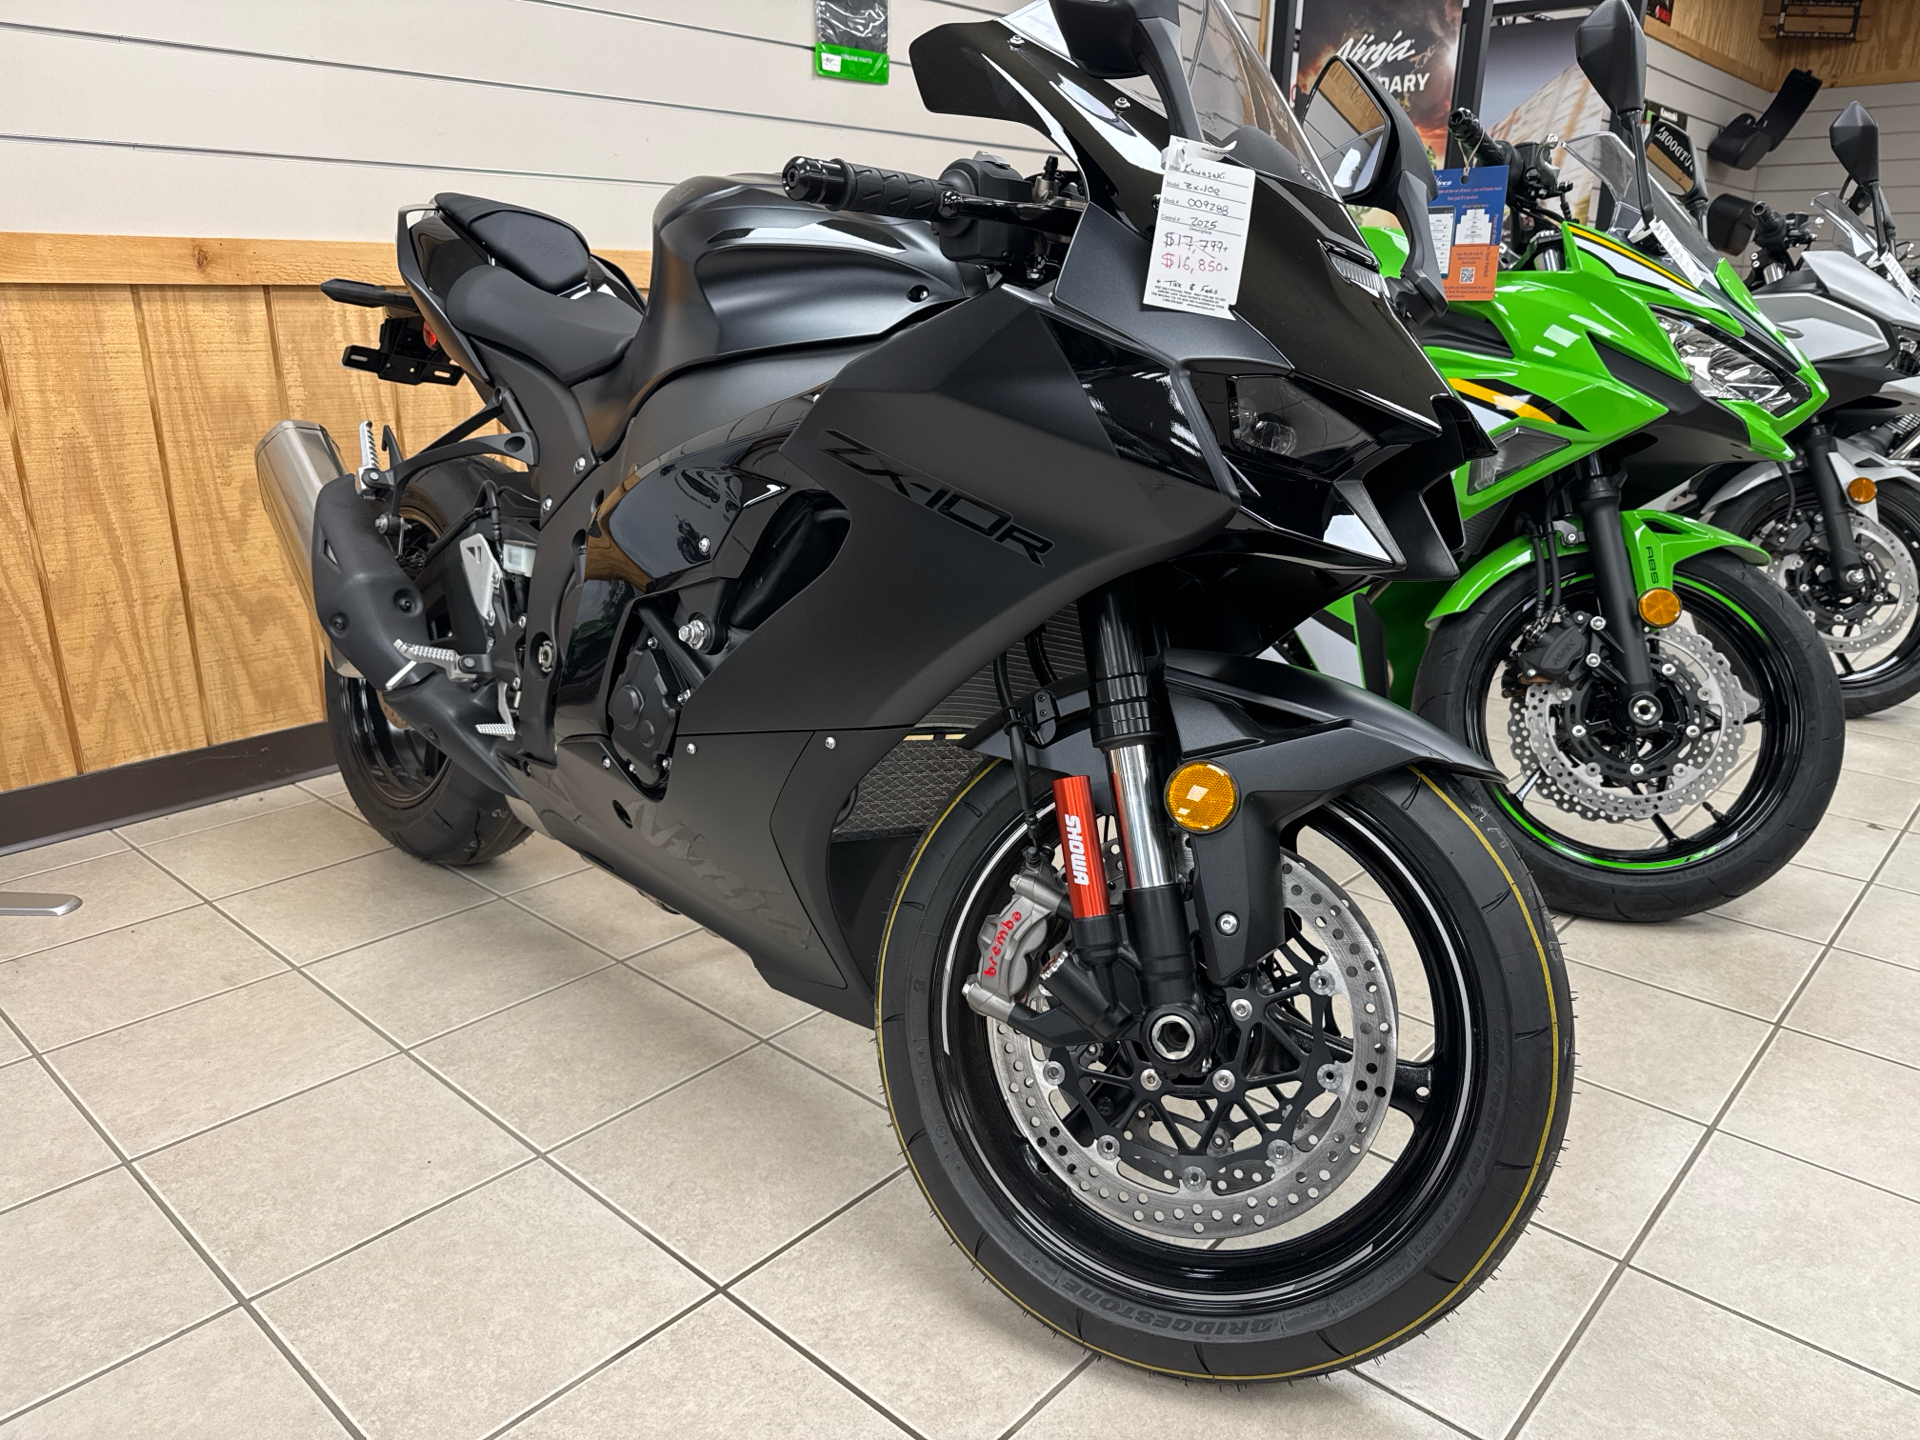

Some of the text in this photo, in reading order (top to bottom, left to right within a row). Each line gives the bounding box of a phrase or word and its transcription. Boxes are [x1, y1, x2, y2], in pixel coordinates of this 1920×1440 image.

[1336, 30, 1416, 72] Ninja
[1184, 164, 1226, 179] Kawasaki
[1188, 198, 1228, 216] 009288
[1190, 217, 1218, 230] 2025
[1164, 280, 1182, 288] Tax
[1201, 284, 1218, 294] Fees
[817, 429, 1055, 568] ZX-10R
[1645, 546, 1659, 584] ABS
[1064, 814, 1090, 886] SHOWA
[982, 911, 1022, 978] brembo
[1062, 1278, 1275, 1334] BRIDGESTONE
